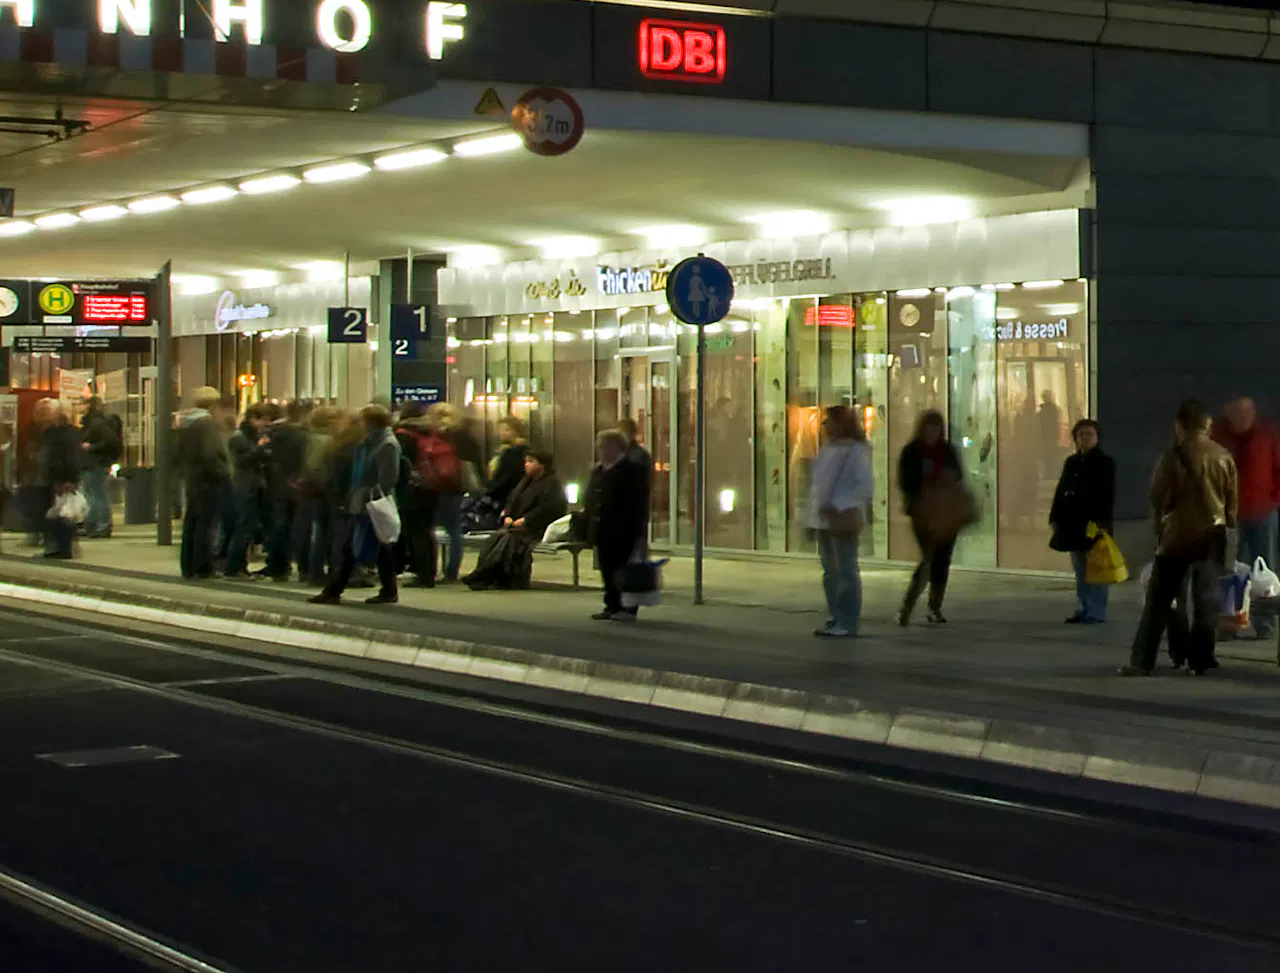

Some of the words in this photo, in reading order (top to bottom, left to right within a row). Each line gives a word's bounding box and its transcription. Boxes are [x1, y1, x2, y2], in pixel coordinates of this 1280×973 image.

[650, 27, 715, 74] DB
[343, 310, 362, 335] 2
[413, 306, 427, 333] 1
[395, 339, 409, 355] 2
